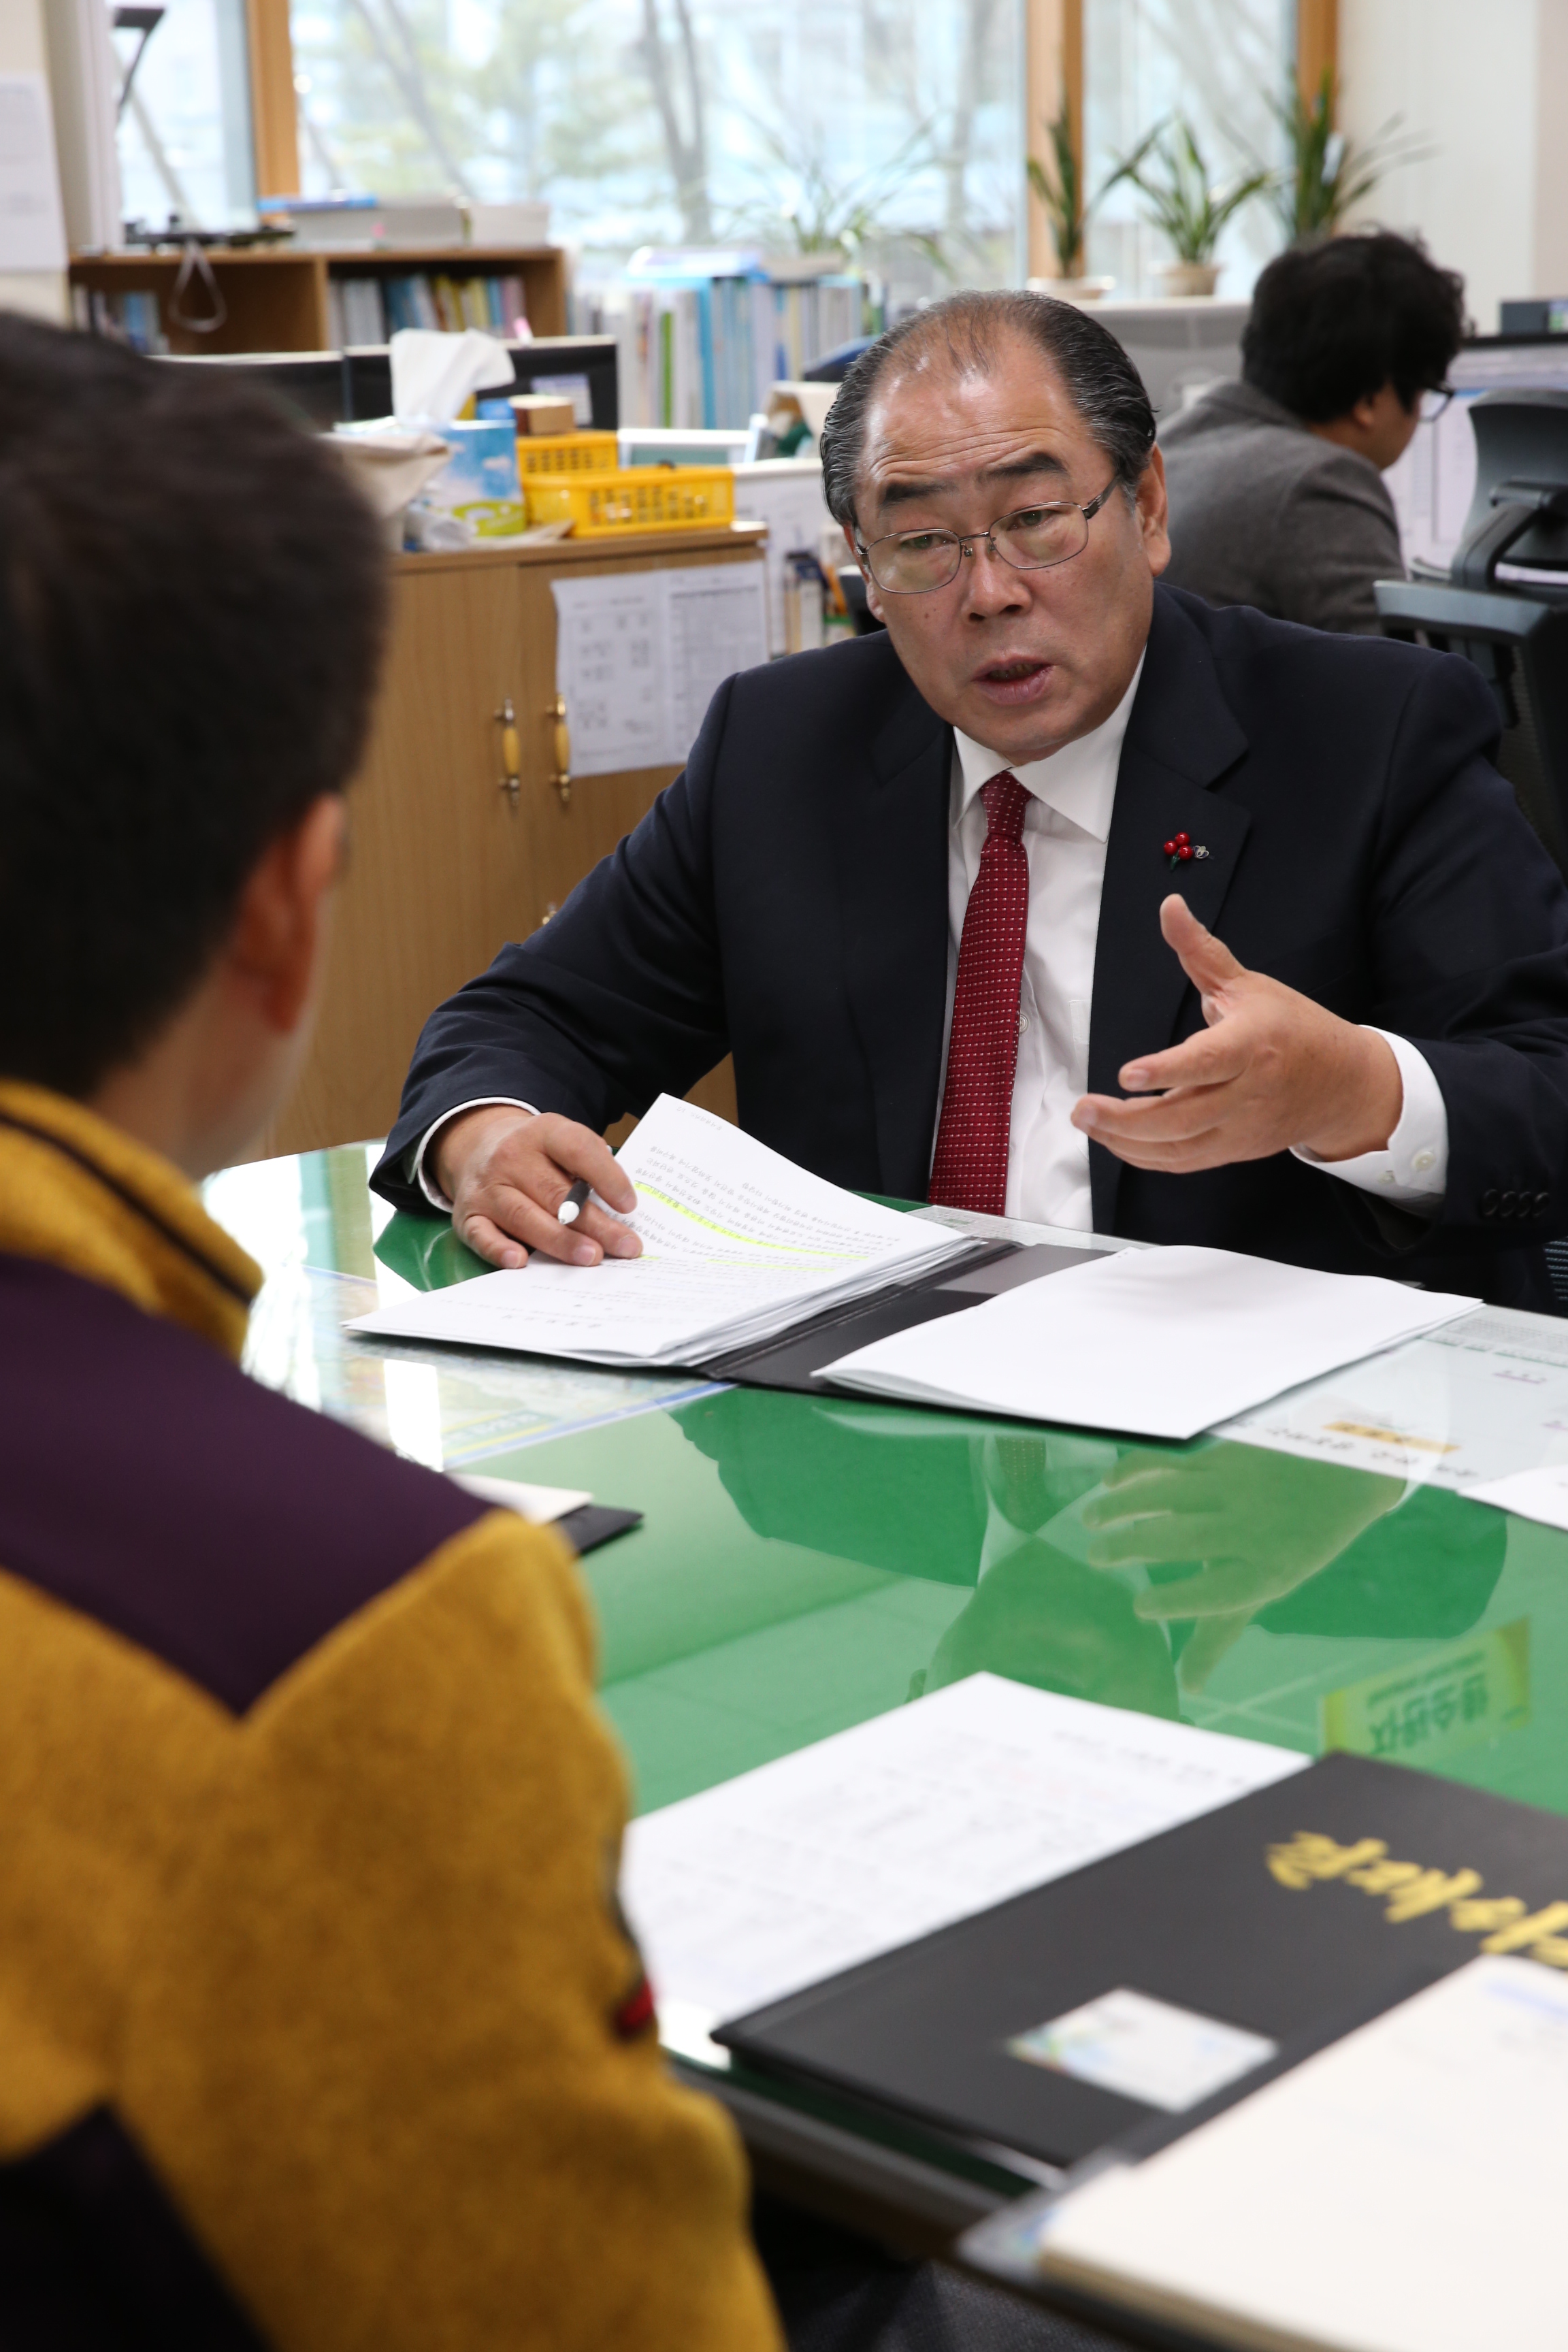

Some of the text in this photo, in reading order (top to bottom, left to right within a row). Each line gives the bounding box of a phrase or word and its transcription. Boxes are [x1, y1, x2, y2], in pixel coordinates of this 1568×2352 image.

[647, 1158, 674, 1173] 판단되는
[678, 1159, 713, 1181] 못하였기에
[677, 1174, 698, 1188] 것으로
[665, 1181, 701, 1205] 49호선에서
[702, 1188, 717, 1200] 않을
[742, 1182, 762, 1196] 타당함
[719, 1198, 740, 1213] 해치지
[738, 1194, 770, 1213] 제한사항을
[765, 1195, 791, 1211] 허가함이
[705, 1206, 723, 1218] 지방도
[745, 1213, 764, 1224] 미관을
[794, 1209, 808, 1218] 변경
[638, 1212, 665, 1230] 아니라는
[727, 1218, 754, 1232] 적정하며
[668, 1230, 689, 1243] 대상이
